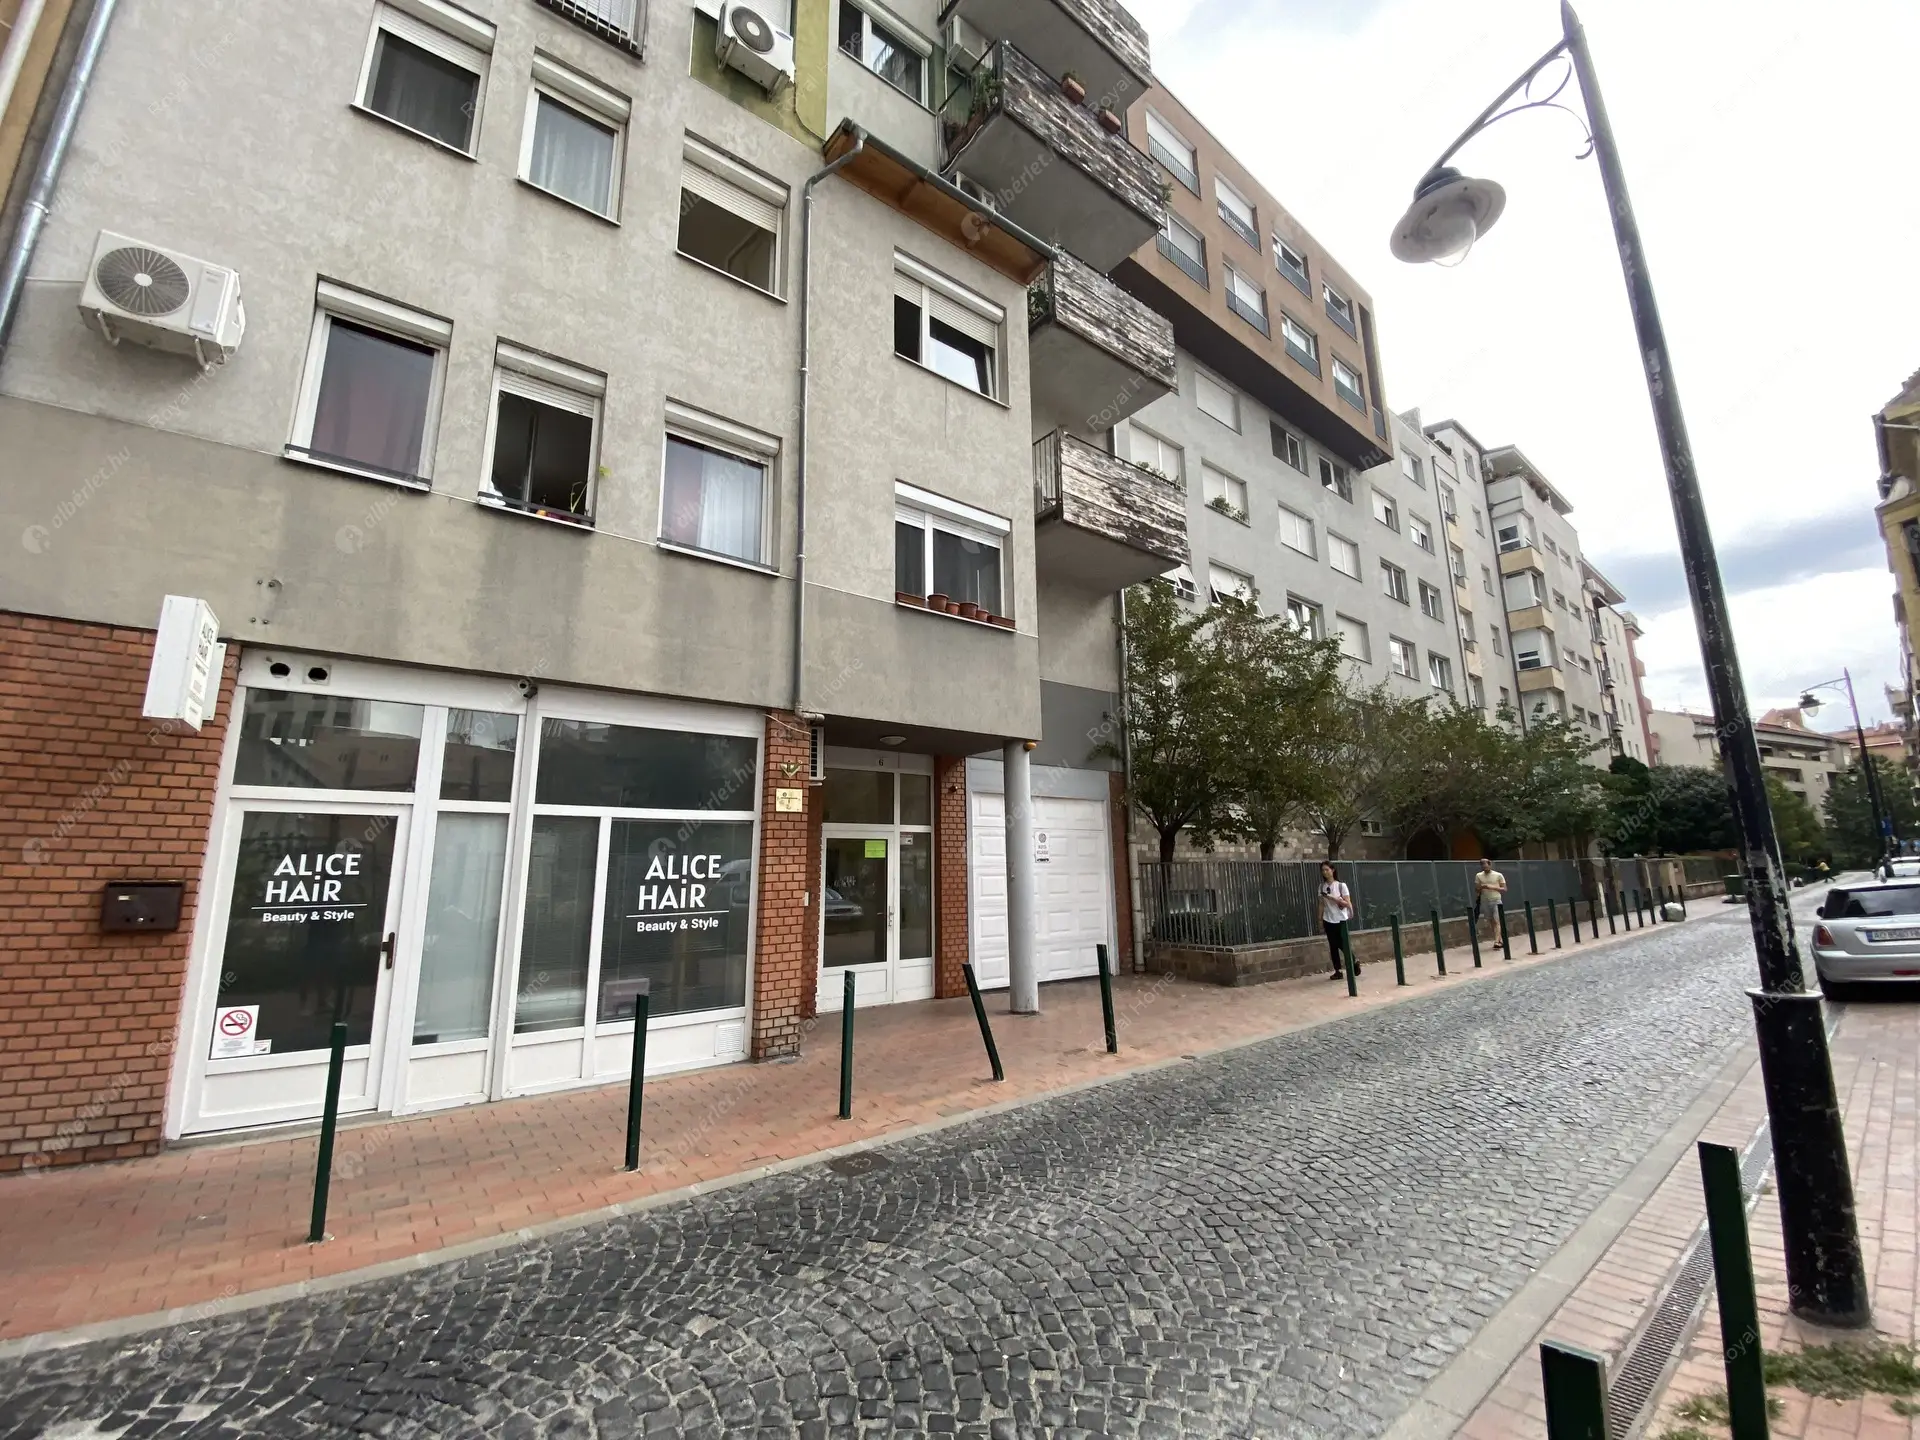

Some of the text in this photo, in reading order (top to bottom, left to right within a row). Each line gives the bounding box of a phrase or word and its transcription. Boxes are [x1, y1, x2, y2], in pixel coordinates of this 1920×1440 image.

[878, 758, 884, 767] 6
[274, 853, 362, 876] ALICE
[644, 855, 722, 880] ALICE
[262, 910, 355, 923] Beauty & Style
[636, 917, 719, 933] Beauty & Style
